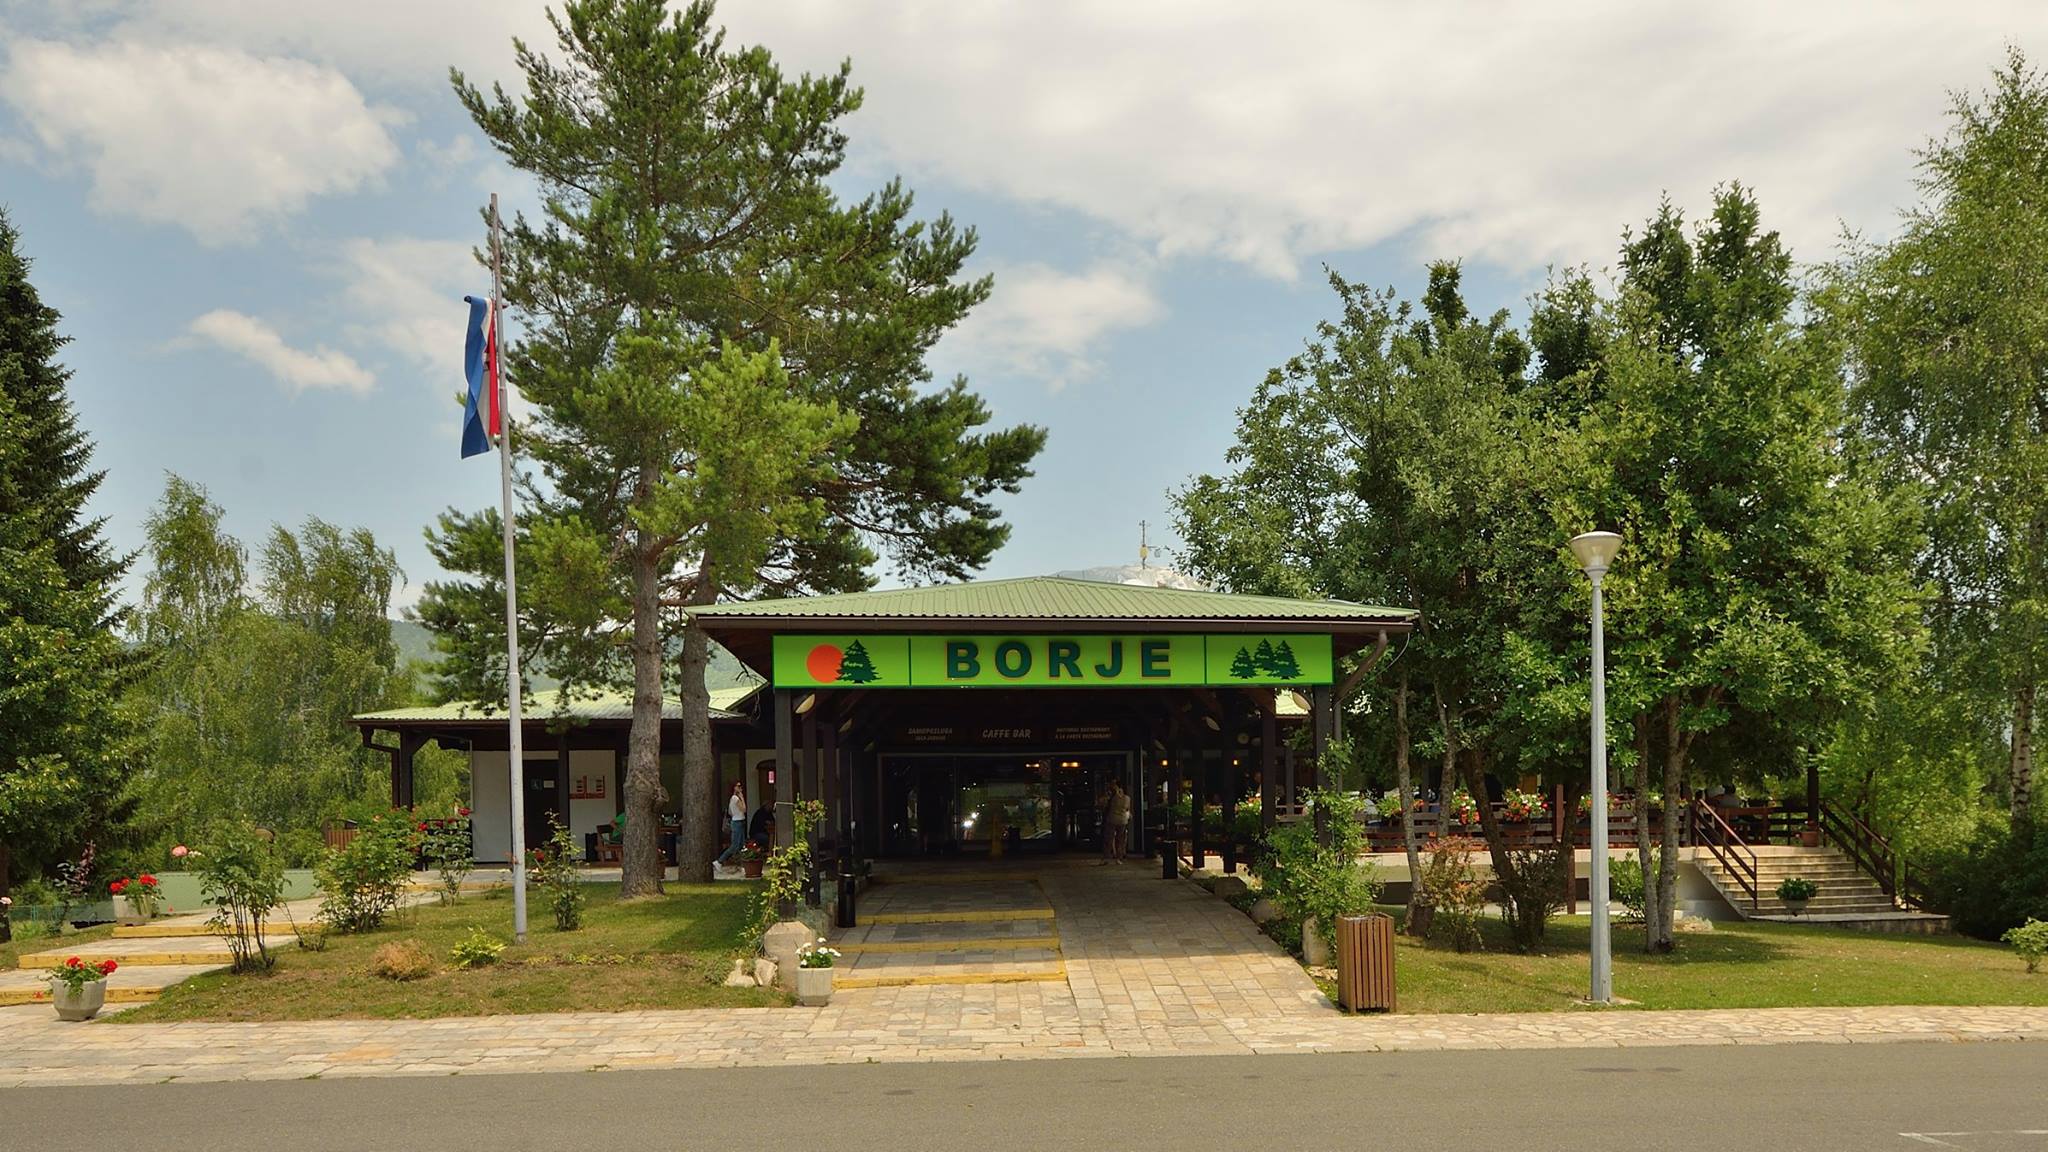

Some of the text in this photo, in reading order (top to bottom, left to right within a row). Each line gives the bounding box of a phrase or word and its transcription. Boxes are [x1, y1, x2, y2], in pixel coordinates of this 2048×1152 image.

[946, 640, 1171, 679] BORJE
[982, 728, 1032, 738] CAFFE BAR
